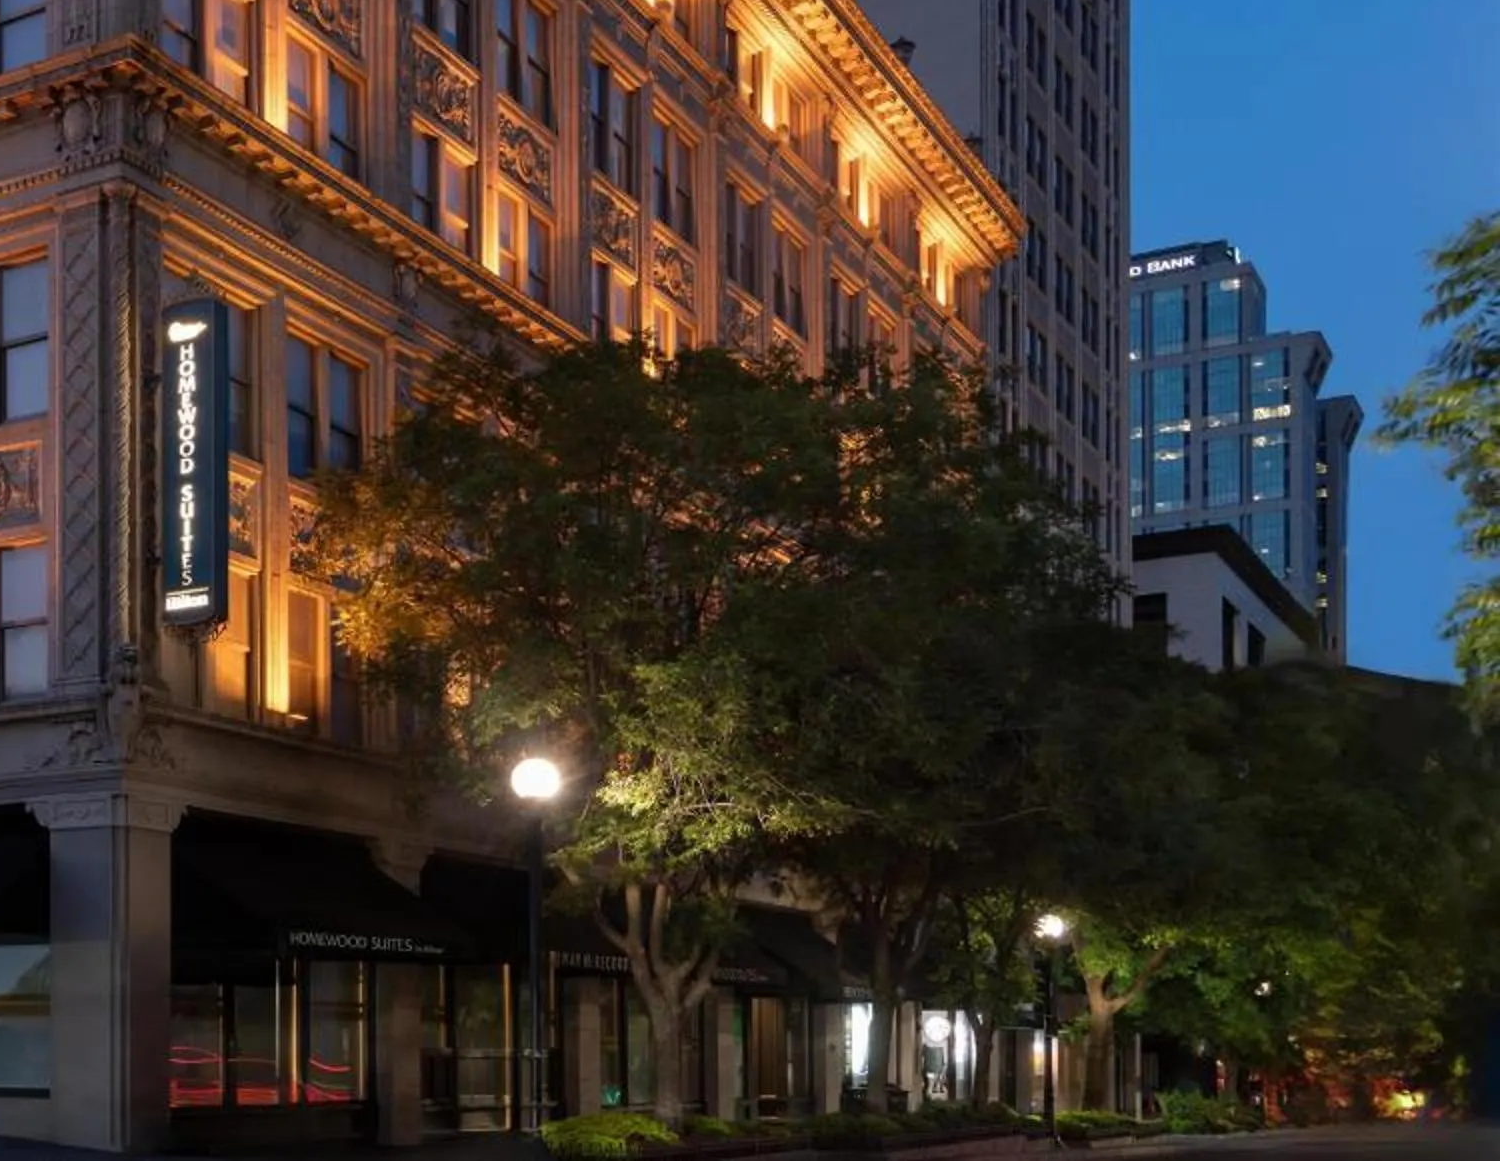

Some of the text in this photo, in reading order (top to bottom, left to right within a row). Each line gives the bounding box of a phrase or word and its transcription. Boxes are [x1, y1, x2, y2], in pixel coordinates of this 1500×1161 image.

[1147, 254, 1196, 273] BANK
[178, 344, 196, 587] HOMEWOOD SUITES
[290, 930, 369, 948] HOMEWOOD
[371, 936, 414, 952] SUITES
